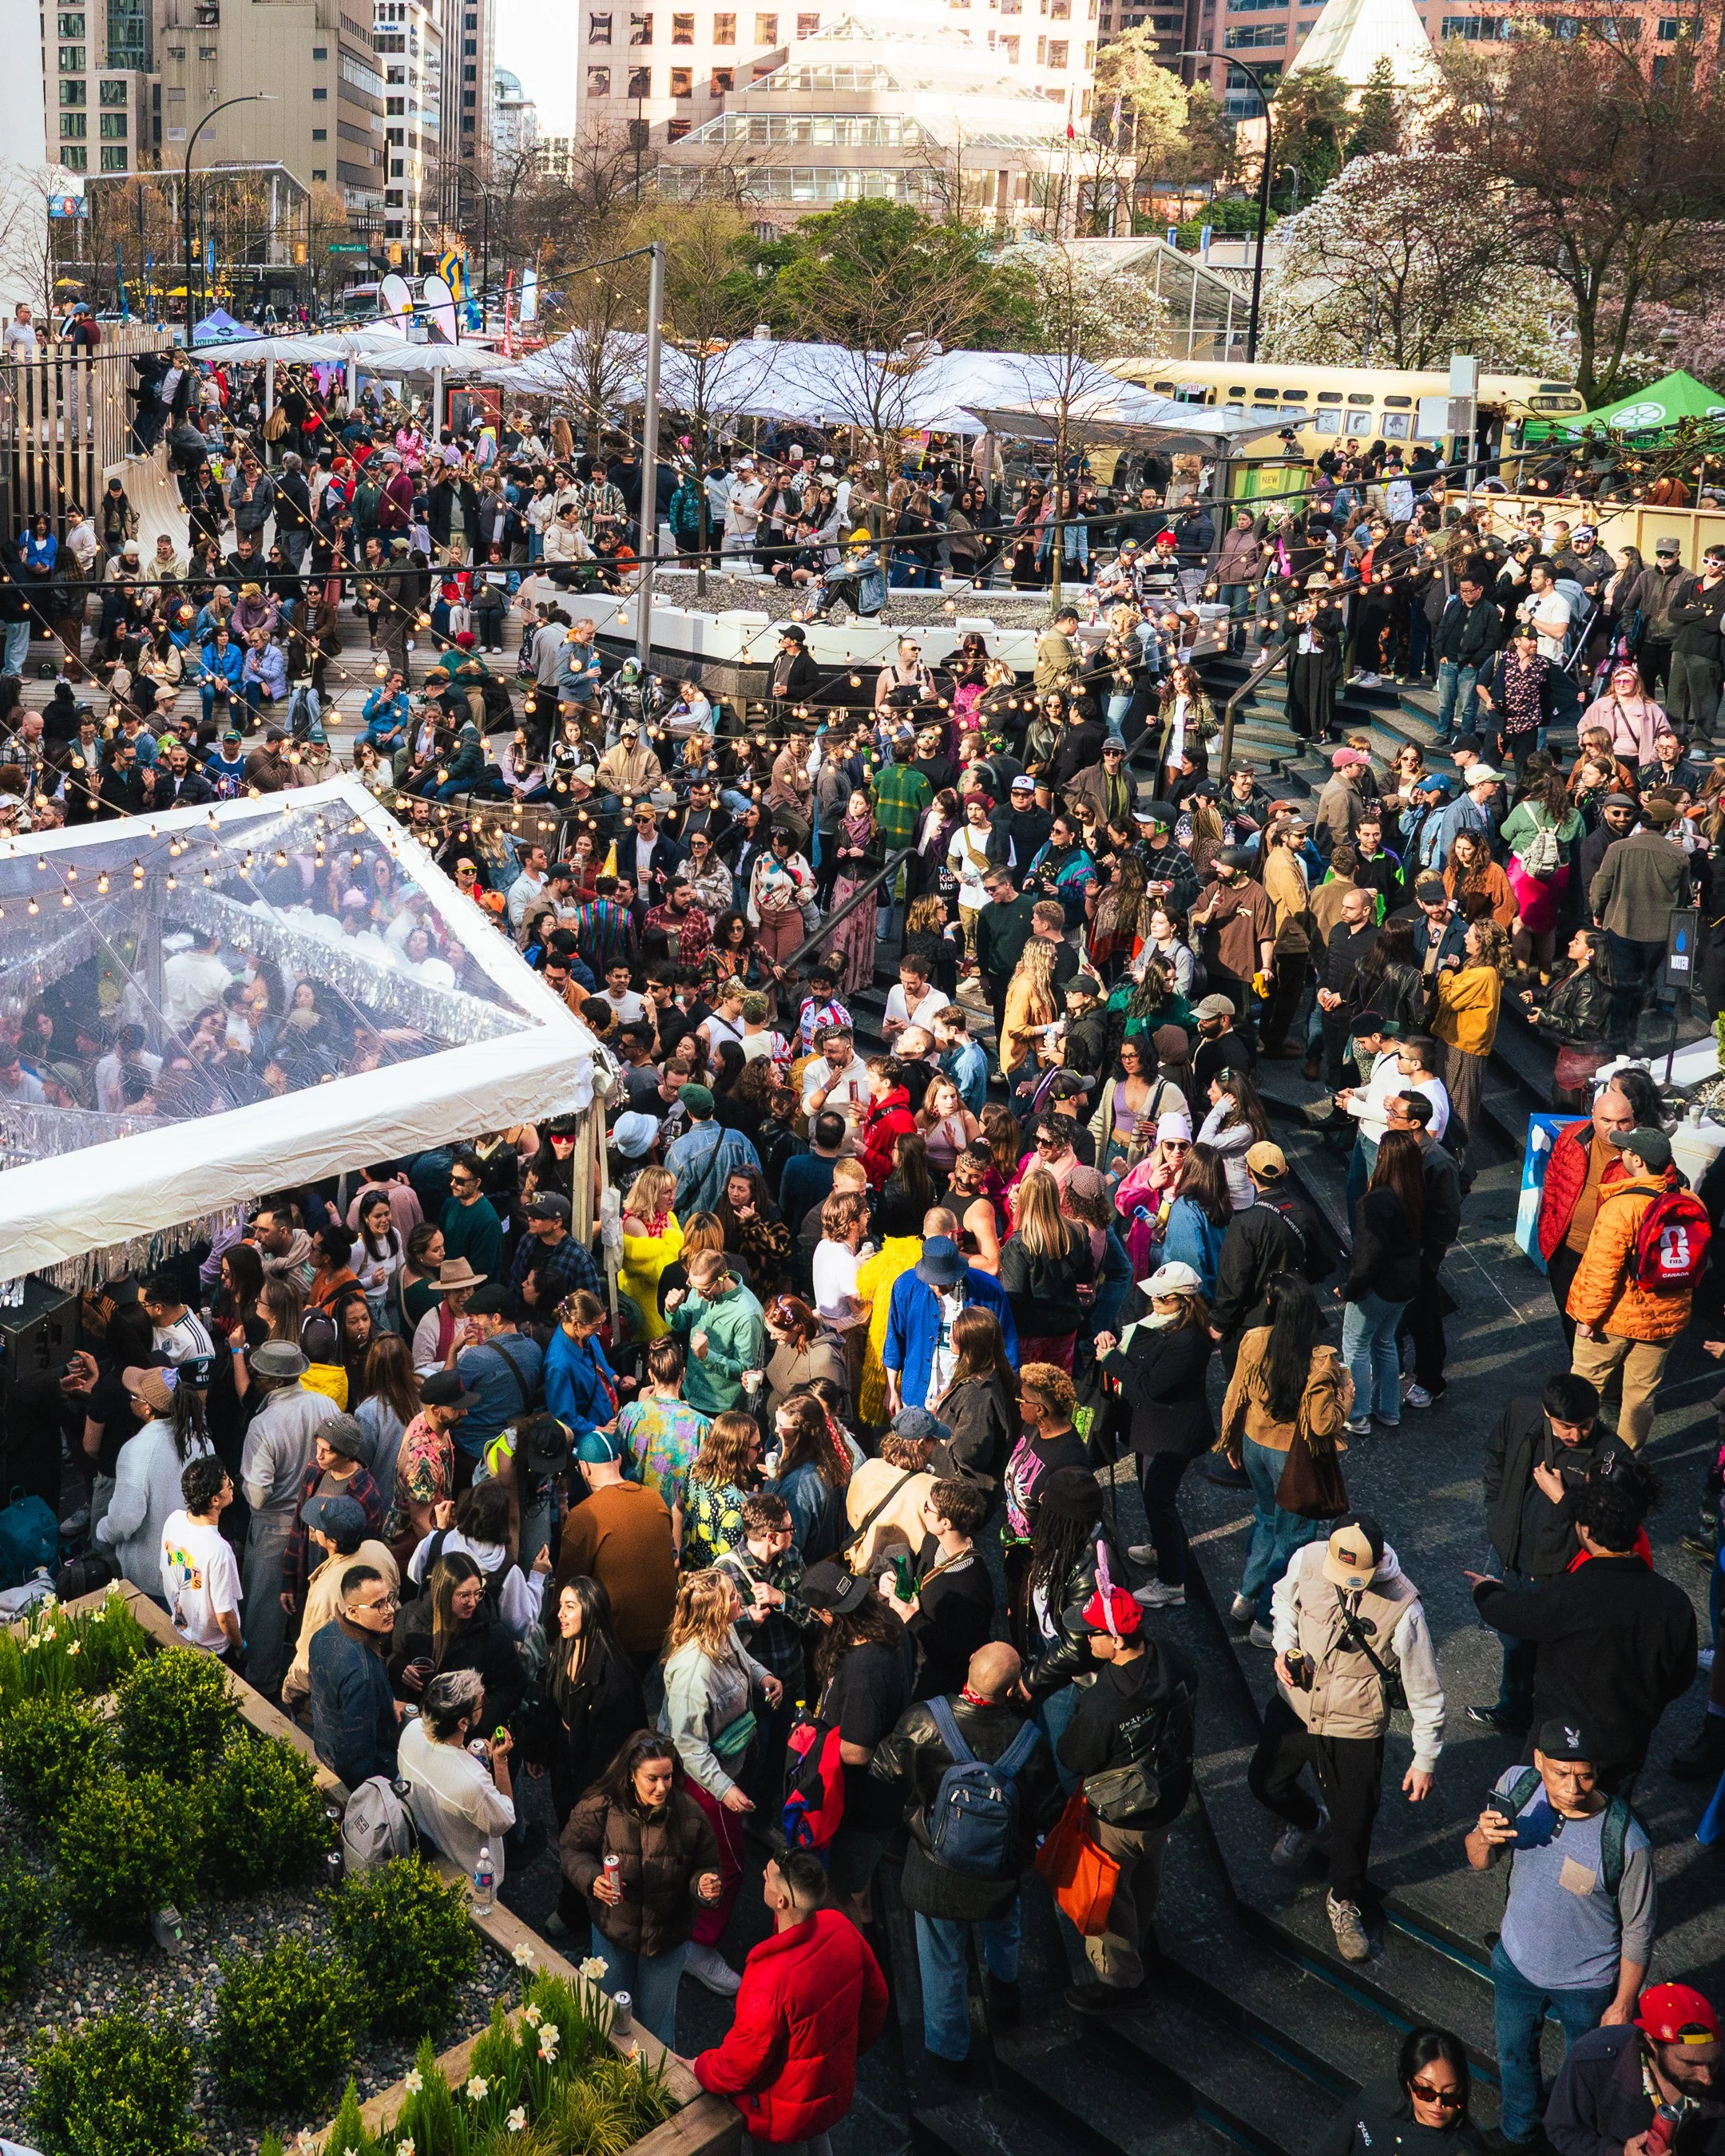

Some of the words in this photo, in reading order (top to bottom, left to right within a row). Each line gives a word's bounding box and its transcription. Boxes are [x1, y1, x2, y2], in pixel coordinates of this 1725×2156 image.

[1262, 475, 1279, 485] NEW
[1671, 954, 1689, 970] WATER
[1283, 1215, 1300, 1235] UNDER
